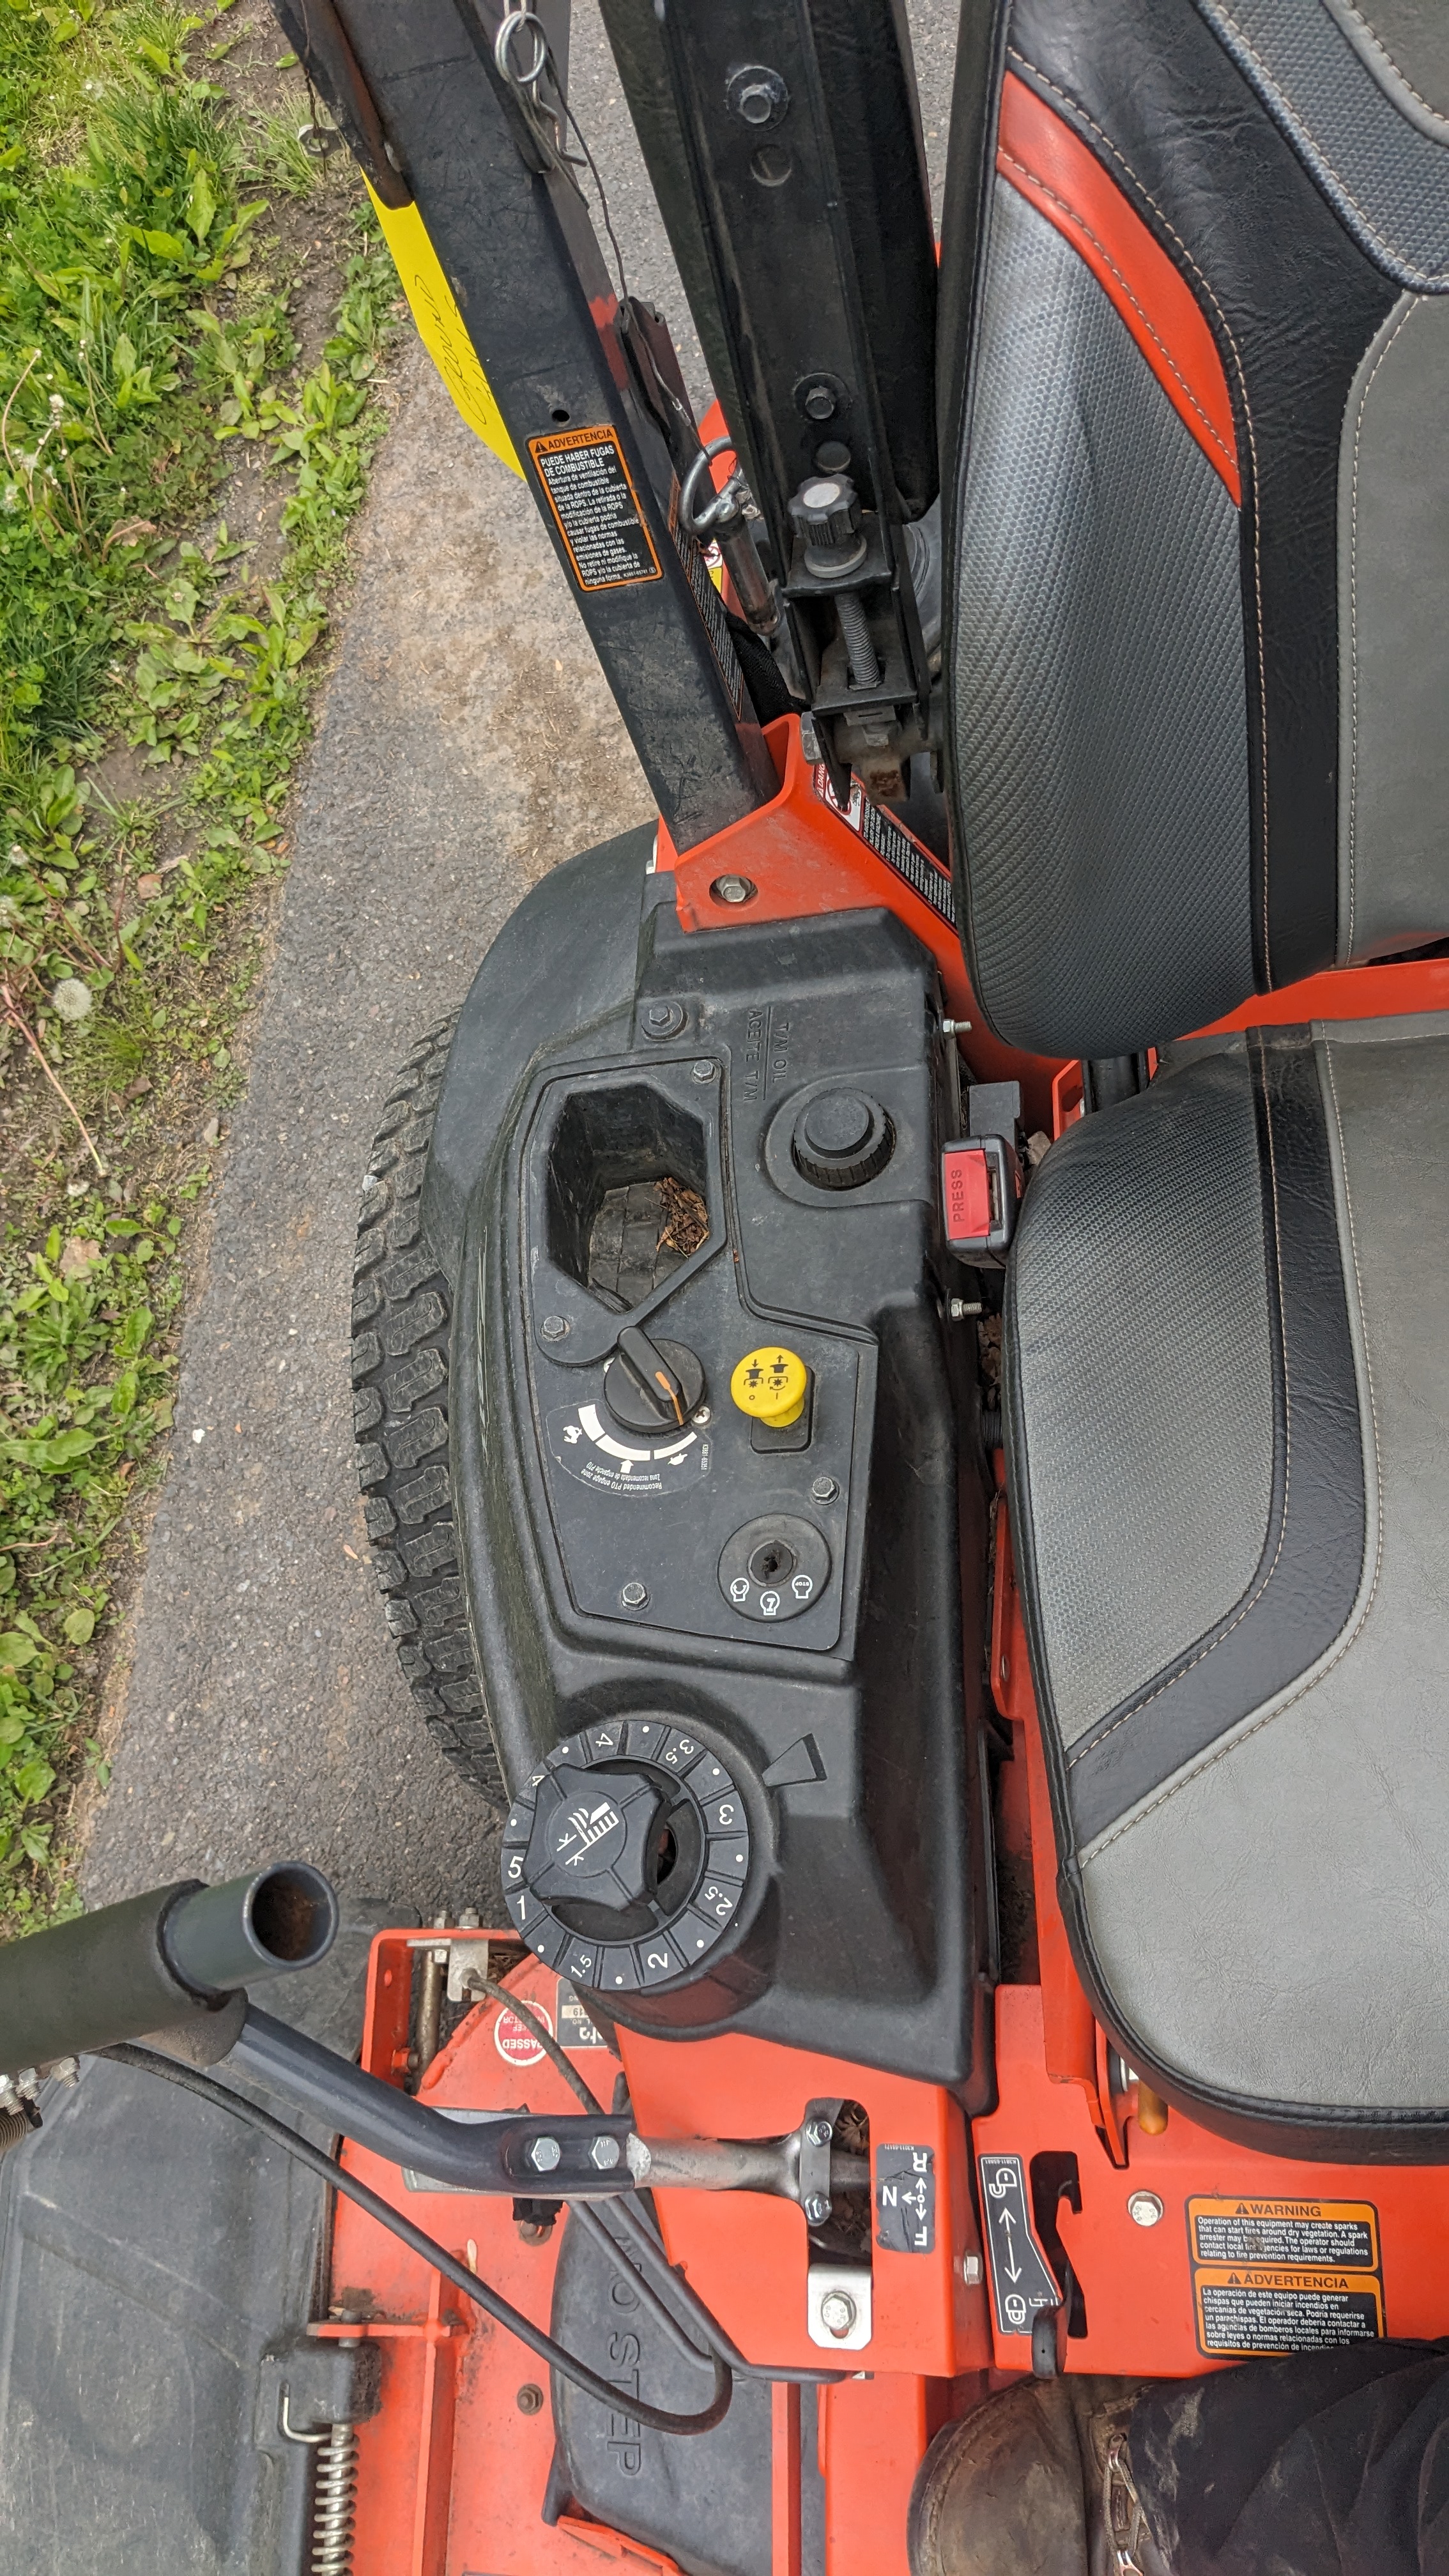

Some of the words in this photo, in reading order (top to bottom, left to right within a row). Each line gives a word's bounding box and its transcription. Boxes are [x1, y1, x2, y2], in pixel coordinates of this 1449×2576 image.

[547, 429, 613, 449] ADVERTENCIA
[540, 455, 565, 467] PUEDE
[565, 450, 590, 463] HABER
[590, 445, 615, 457] FUGAS
[544, 467, 555, 477] DE
[555, 457, 604, 475] COMBUSTIBLE
[548, 475, 571, 486] Abertura
[551, 484, 570, 495] tanque
[569, 482, 578, 491] de
[577, 477, 610, 489] combustible
[554, 493, 574, 503] situada
[574, 489, 592, 499] dentro
[604, 483, 627, 493] cubierta
[746, 1010, 763, 1062] ACEITE
[774, 1022, 789, 1052] T/M
[772, 1058, 787, 1084] OIL
[744, 1070, 758, 1101] T/M
[950, 1169, 965, 1223] PRESS
[581, 1469, 593, 1478] zone
[586, 1461, 596, 1470] PTO
[592, 1475, 611, 1486] engage
[649, 1473, 661, 1482] Zona
[611, 1482, 622, 1491] PTO
[595, 1733, 614, 1747] 4
[665, 1739, 694, 1765] 3.5
[719, 1804, 734, 1825] 3
[508, 1855, 524, 1878] 5
[516, 1895, 526, 1920] 1
[704, 1885, 733, 1916] 2.5
[571, 1954, 592, 1978] 1.5
[647, 1952, 668, 1970] 2
[913, 2152, 927, 2172] R
[882, 2186, 898, 2206] N
[1250, 2204, 1321, 2217] WARNING
[1197, 2216, 1231, 2227] Operation
[1256, 2219, 1293, 2230] equipment
[1294, 2222, 1309, 2230] may
[1334, 2222, 1358, 2232] sparks
[914, 2226, 927, 2246] F
[1255, 2235, 1284, 2246] equired.
[1300, 2237, 1322, 2247] operator
[1324, 2237, 1354, 2246] should
[1262, 2227, 1286, 2235] around
[1288, 2228, 1300, 2238] dry
[1301, 2229, 1340, 2240] vegetation.
[1348, 2231, 1368, 2241] spark
[1200, 2249, 1226, 2259] relating
[1249, 2251, 1285, 2262] prevention
[1287, 2253, 1335, 2264] requirements.
[1328, 2246, 1368, 2257] regulations
[1243, 2273, 1348, 2288] ADVERTENCIA
[1203, 2296, 1229, 2306] chispas
[1231, 2299, 1244, 2307] que
[1245, 2298, 1270, 2308] pueden
[1295, 2300, 1328, 2309] incendios
[1213, 2288, 1246, 2299] operación
[1273, 2291, 1298, 2301] equipo
[1299, 2292, 1320, 2303] puede
[1322, 2295, 1348, 2304] generar
[1215, 2313, 1257, 2325] parachispas.
[1268, 2316, 1298, 2327] operador
[1327, 2319, 1359, 2327] contactar
[1248, 2306, 1285, 2318] vegetación
[1330, 2310, 1364, 2322] requerirse
[1217, 2322, 1247, 2333] agencias
[1259, 2324, 1292, 2333] bomberos
[1294, 2326, 1319, 2334] locales
[1321, 2329, 1335, 2337] para
[1337, 2328, 1374, 2336] informarse
[1227, 2331, 1245, 2341] leyes
[1279, 2334, 1322, 2343] relacionadas
[1207, 2338, 1240, 2349] requisitos
[1252, 2341, 1289, 2352] prevención
[607, 2332, 641, 2476] STEP
